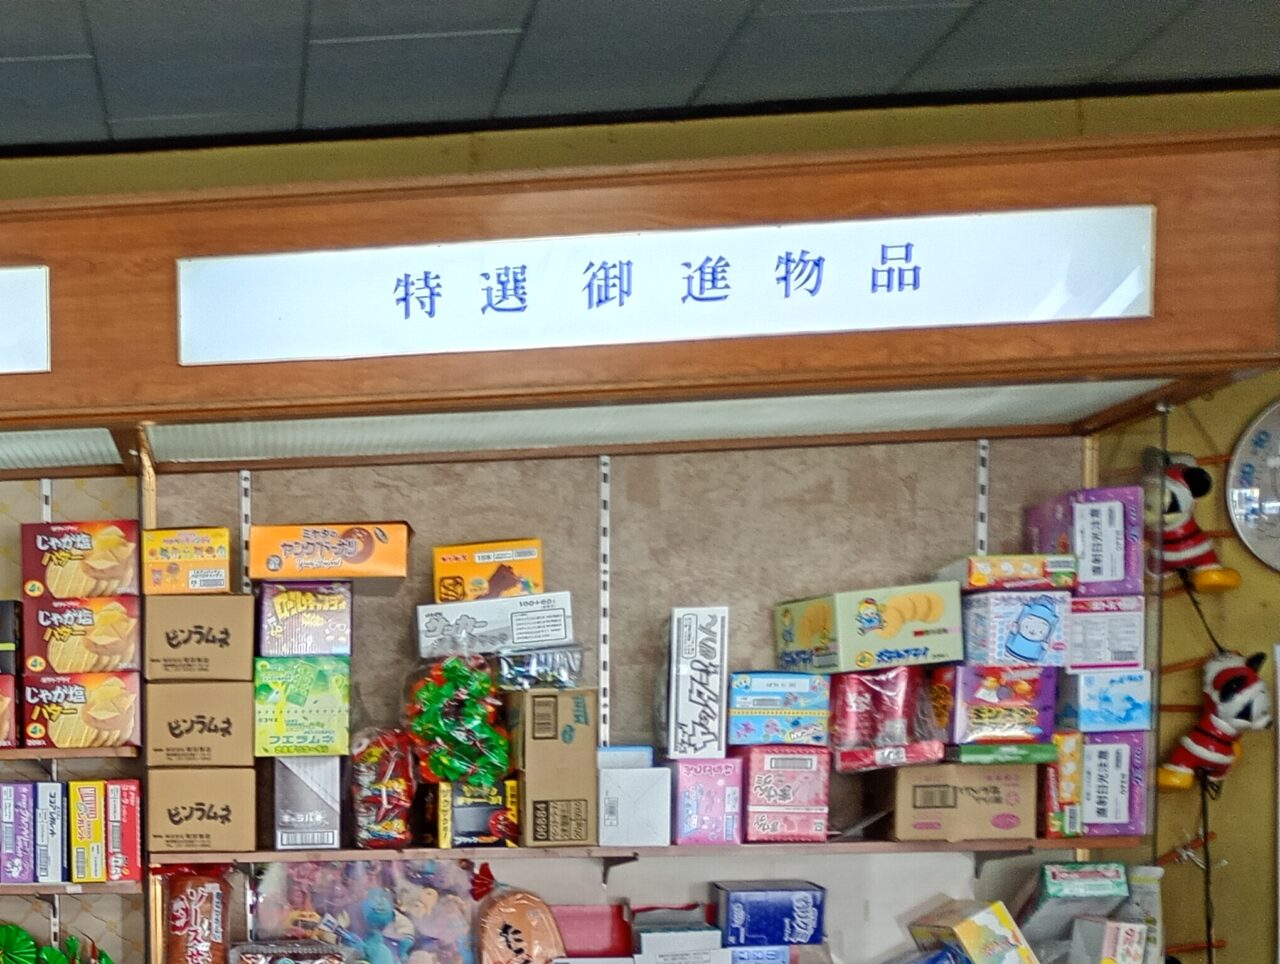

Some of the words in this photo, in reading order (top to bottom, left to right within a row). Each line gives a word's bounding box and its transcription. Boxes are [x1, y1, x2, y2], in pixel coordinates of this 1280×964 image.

[392, 241, 923, 321] 特選御進物品
[36, 533, 94, 551] じゃが塩
[38, 608, 95, 627] じゃが塩
[165, 625, 231, 649] ビンラムネ
[25, 685, 87, 705] じゃが塩
[167, 714, 233, 739] ビンラムネ
[166, 802, 233, 826] ビンラムネ
